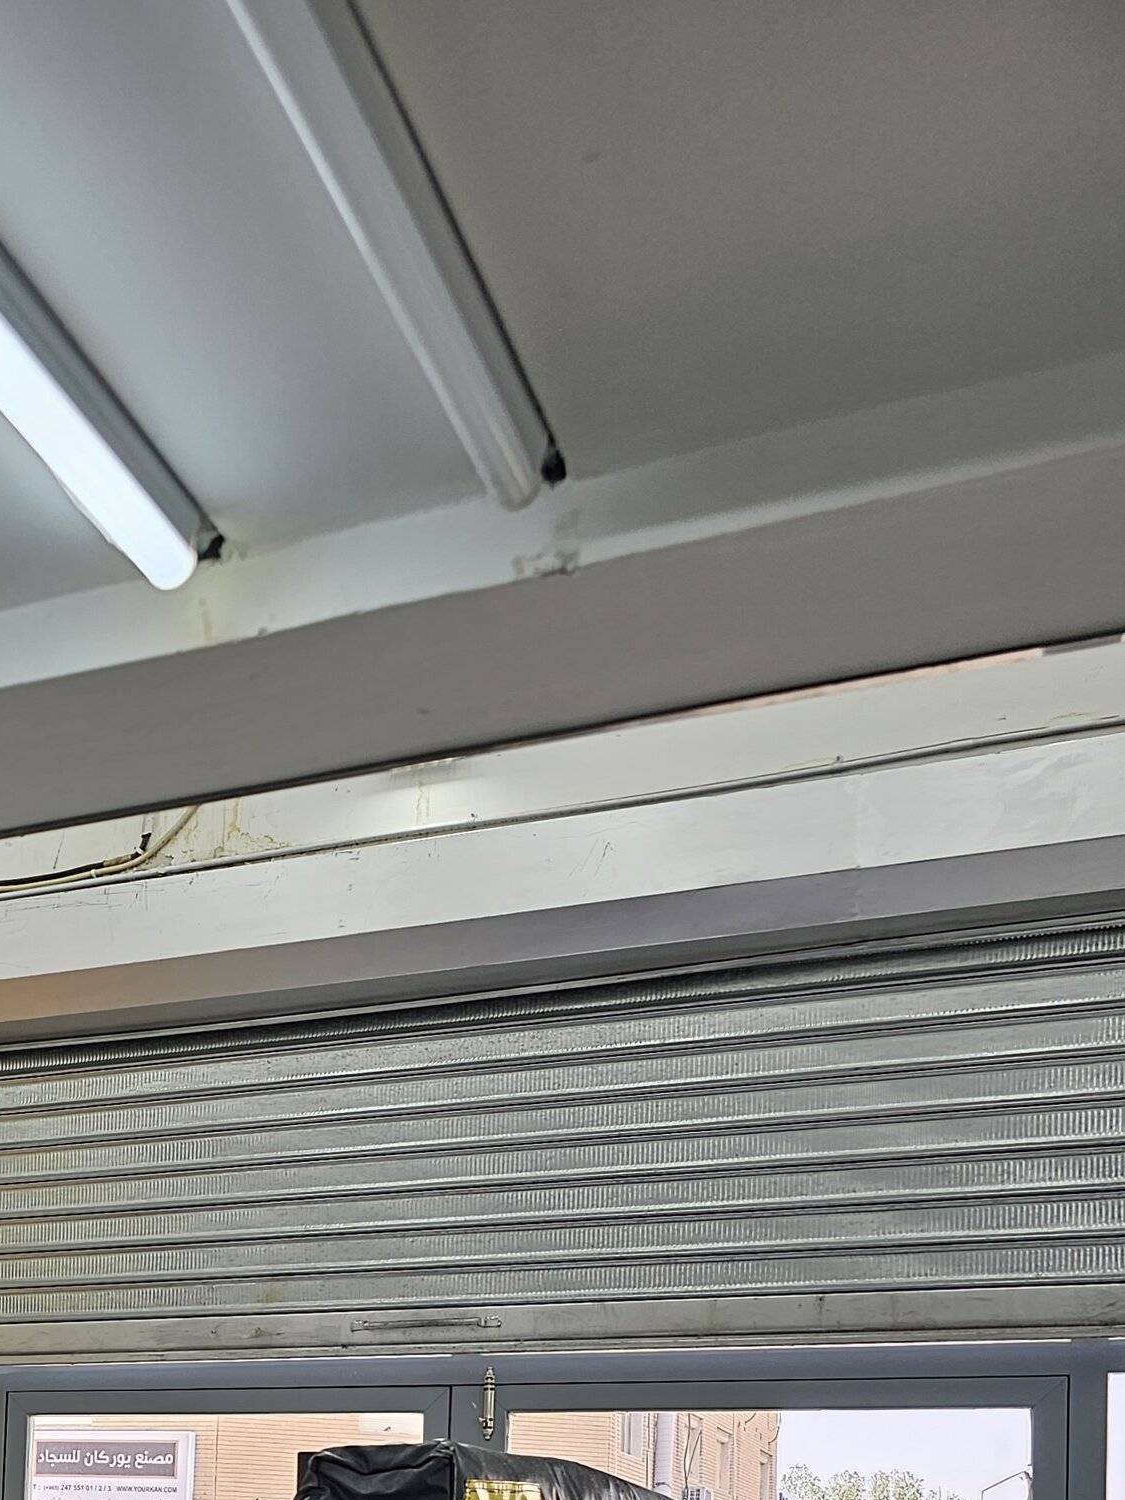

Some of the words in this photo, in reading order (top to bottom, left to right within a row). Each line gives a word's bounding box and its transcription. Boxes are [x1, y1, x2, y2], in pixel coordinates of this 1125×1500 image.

[38, 1449, 81, 1467] للسجاد
[84, 1450, 132, 1468] يوركان
[135, 1450, 174, 1468] مصنع
